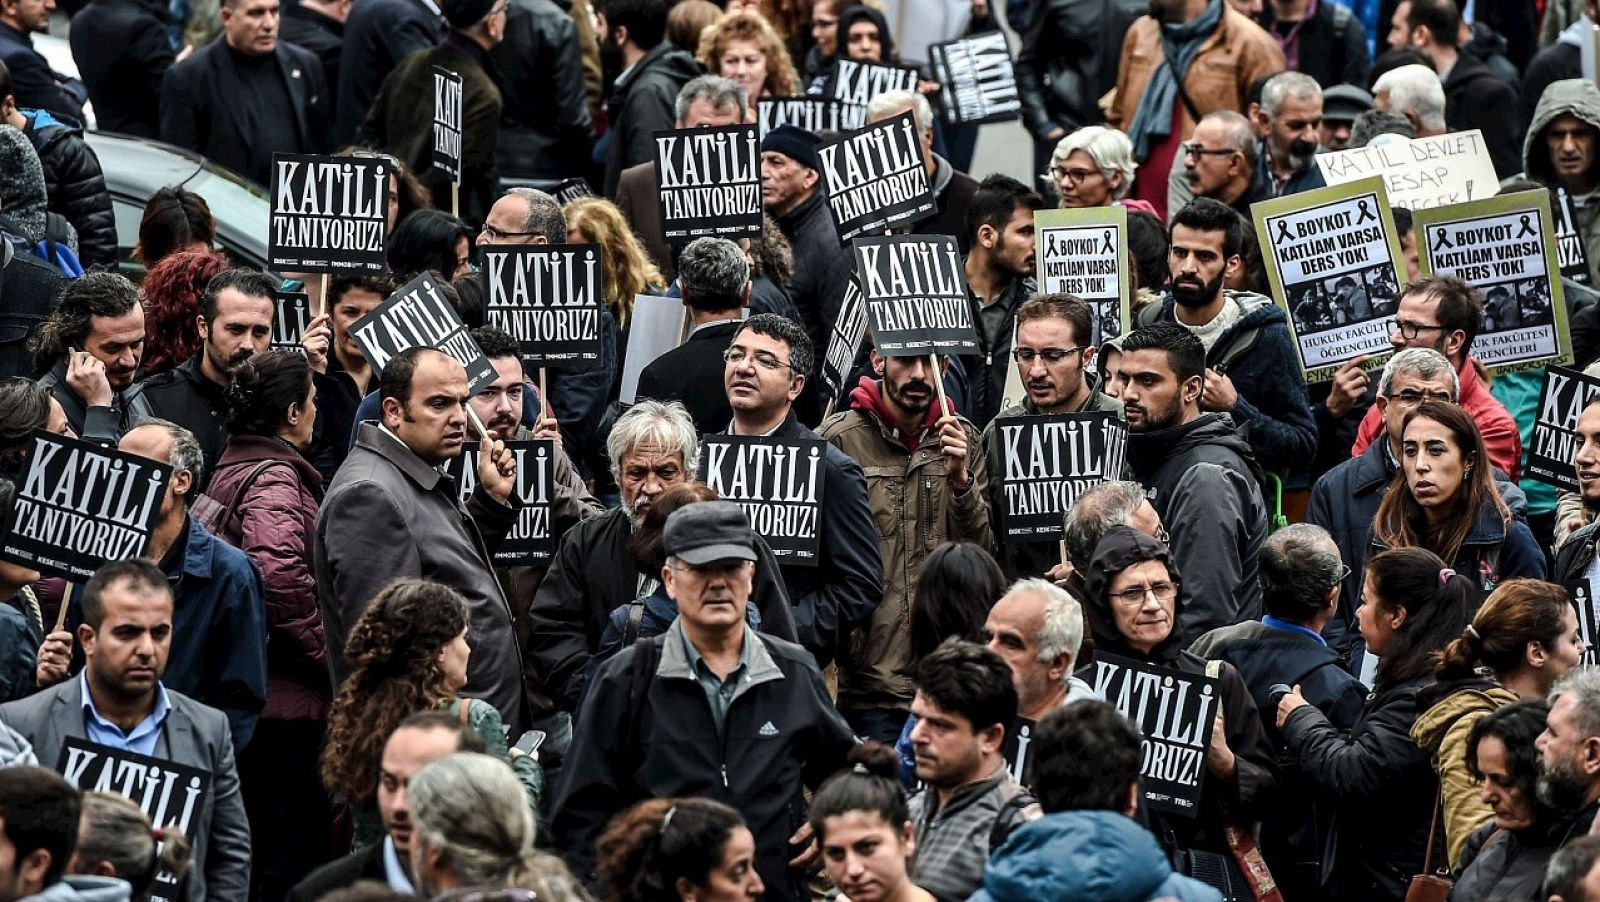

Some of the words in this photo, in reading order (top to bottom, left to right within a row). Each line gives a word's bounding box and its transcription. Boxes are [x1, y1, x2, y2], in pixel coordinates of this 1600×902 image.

[656, 130, 759, 188] KATİLİ
[817, 118, 921, 197] KATİLİ
[1409, 134, 1478, 161] DEVLET
[274, 161, 386, 218] KATİLİ
[660, 183, 760, 220] TANIYORUZ!
[829, 165, 929, 224] TANIYORUZ!
[273, 216, 384, 251] TANIYORUZ!
[1296, 211, 1352, 238] BOYKOT
[1455, 224, 1513, 247] BOYKOT
[1060, 238, 1098, 256] BOYKOT
[1279, 237, 1337, 263] KATLİAM
[1337, 226, 1383, 249] VARSA
[1300, 255, 1335, 275] DERS
[1336, 246, 1369, 267] YOK!
[1435, 248, 1493, 269] KATLİAM
[1495, 241, 1541, 259] VARSA
[486, 250, 597, 307] KATİLİ
[858, 241, 964, 298] KATİLİ
[1047, 259, 1085, 277] KATLİAM
[1086, 259, 1116, 275] VARSA
[1455, 264, 1491, 281] DERS
[1492, 259, 1526, 277] YOK!
[1059, 279, 1083, 294] DERS
[1084, 278, 1105, 293] YOK!
[354, 280, 461, 370] KATİLİ
[487, 309, 598, 341] TANIYORUZ!
[869, 298, 972, 331] TANIYORUZ!
[1304, 332, 1343, 348] HUKUK
[1345, 321, 1387, 339] FAKÜLT
[1472, 342, 1537, 360] RENCİLERİ
[1492, 327, 1549, 346] FAKÜLTESİ
[19, 437, 162, 531] KATİLİ
[706, 443, 821, 503] KATİLİ
[11, 498, 147, 561] TANIYORUZ!
[1093, 660, 1214, 748] KATİLİ
[63, 746, 202, 837] KATİLİ
